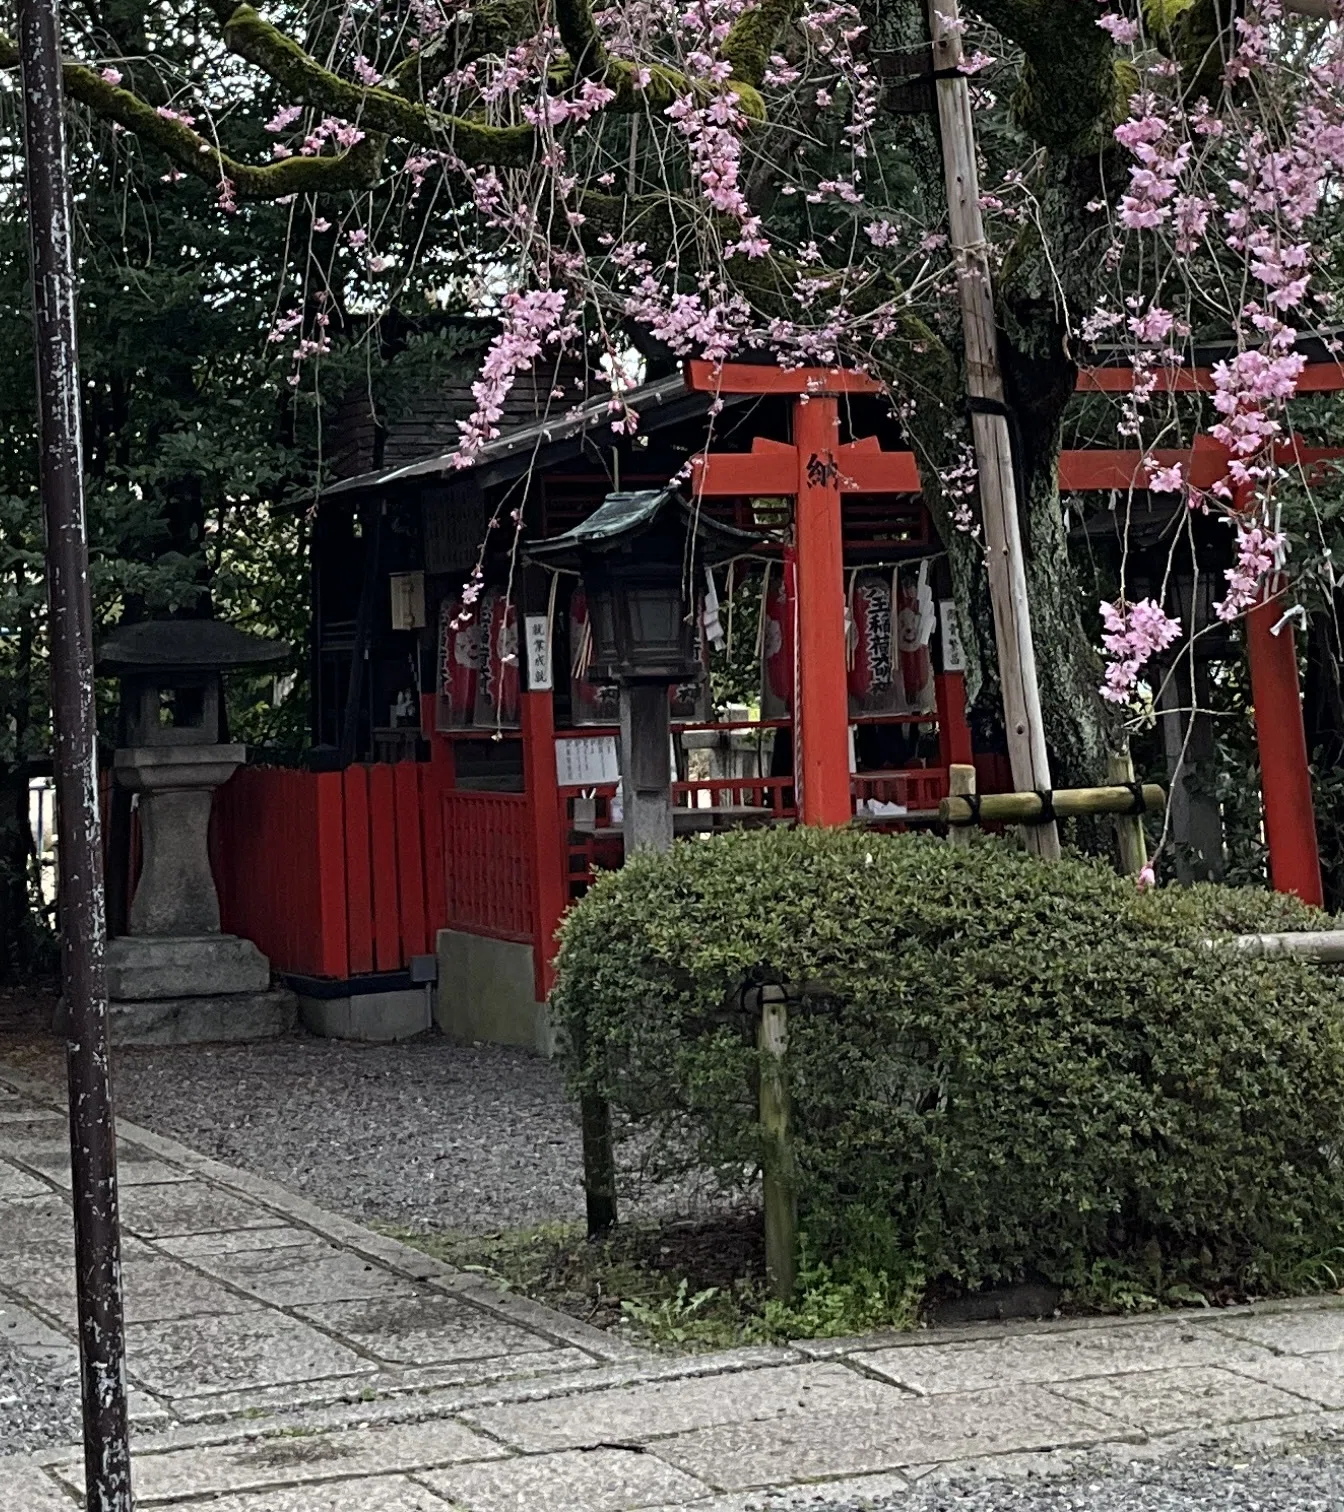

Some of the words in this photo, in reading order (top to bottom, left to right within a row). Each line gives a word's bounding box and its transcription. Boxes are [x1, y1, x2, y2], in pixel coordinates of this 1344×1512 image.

[806, 452, 839, 491] 納
[532, 623, 549, 683] 就業成就
